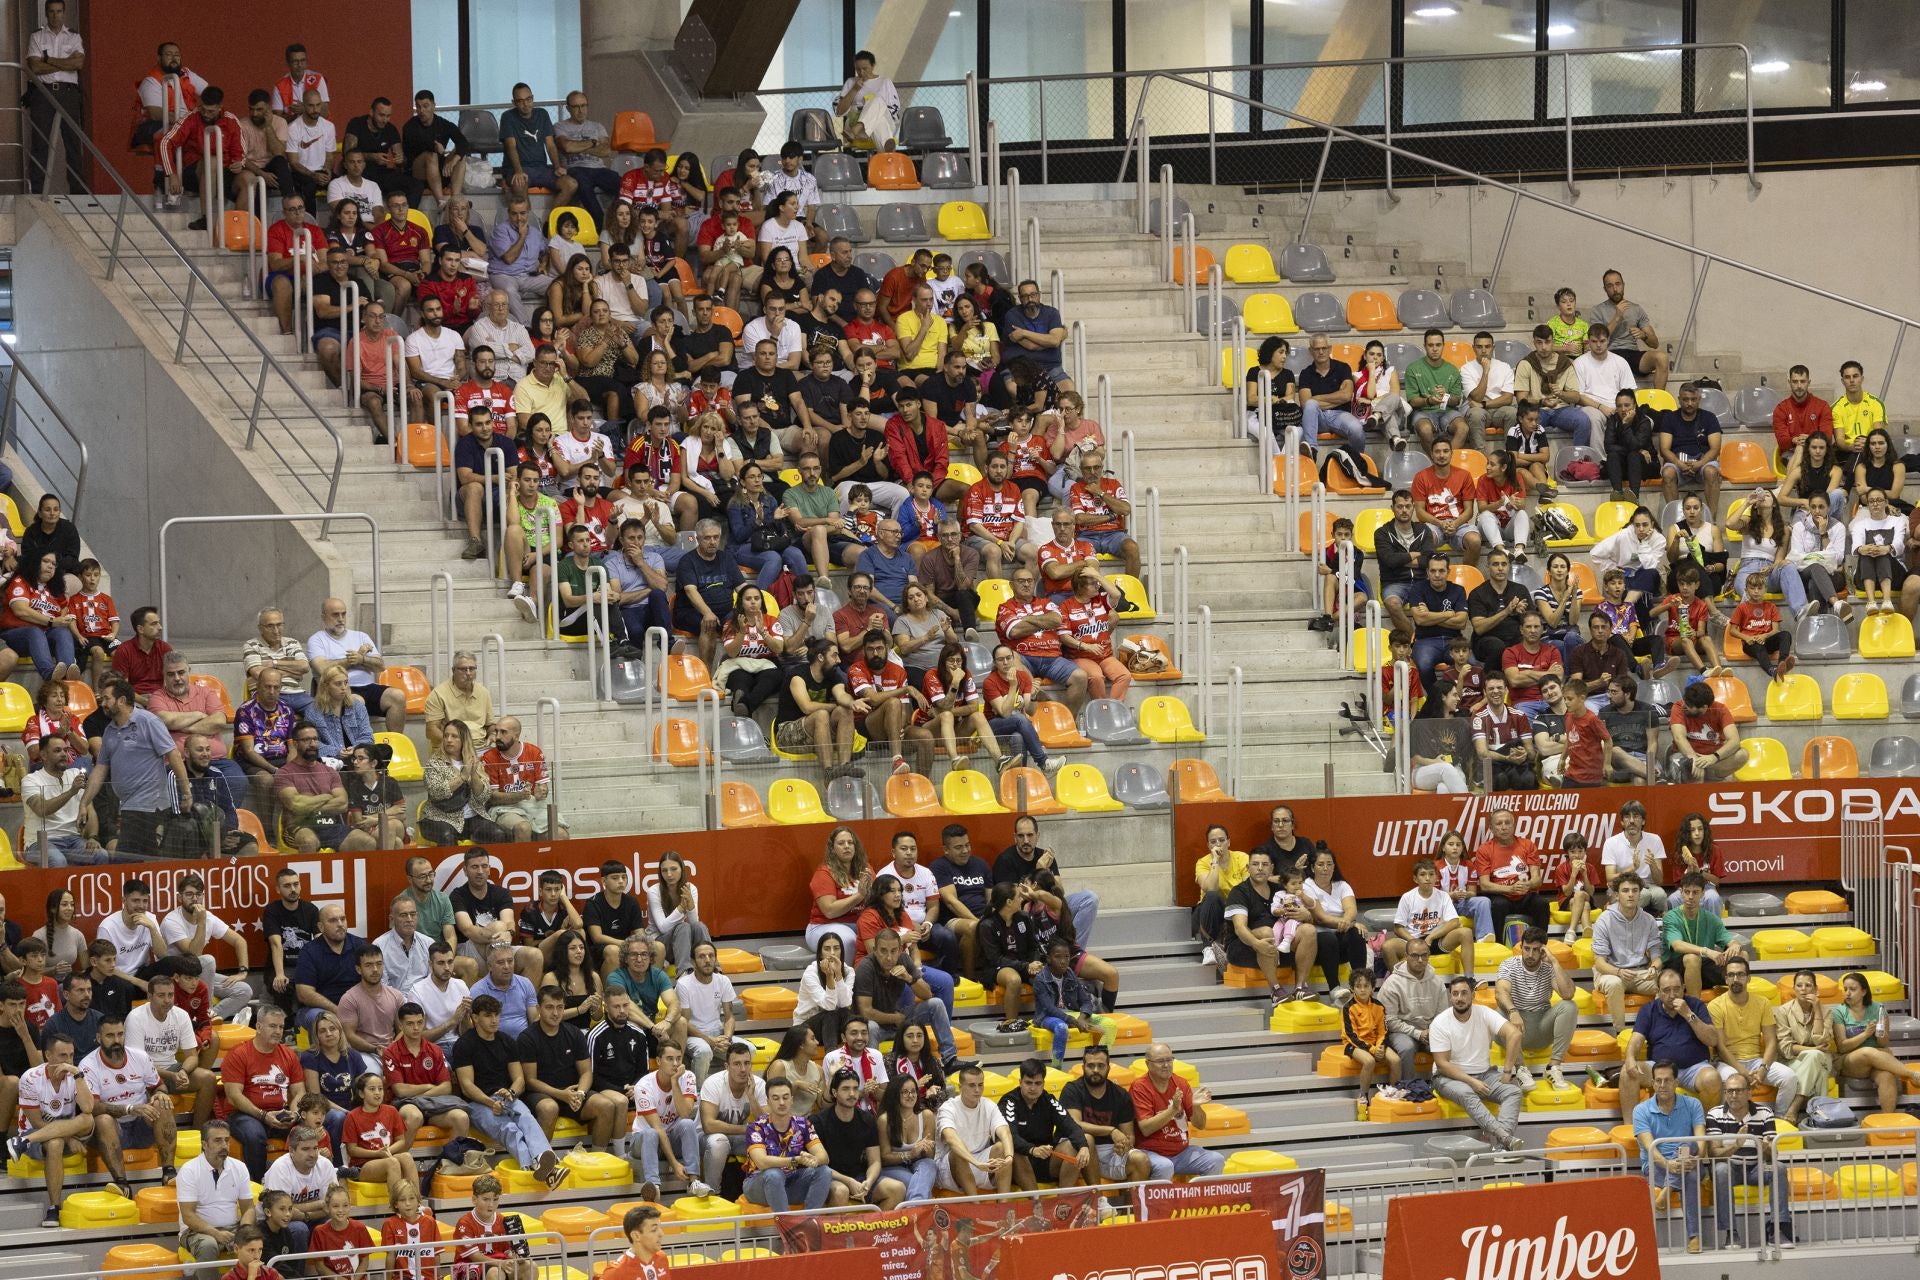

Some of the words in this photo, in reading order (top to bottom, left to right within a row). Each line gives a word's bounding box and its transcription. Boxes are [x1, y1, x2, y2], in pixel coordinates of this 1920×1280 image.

[1524, 793, 1580, 812] VOLCANO
[1708, 787, 1920, 826] SKODA
[1372, 818, 1449, 857] ULTRA
[1474, 812, 1617, 853] MRATHON
[953, 875, 985, 887] adidas
[1413, 911, 1439, 920] SUPER
[1148, 1186, 1201, 1200] JONATHAN
[1203, 1182, 1252, 1196] HENRIQUE
[1279, 1177, 1305, 1241] 7
[823, 1221, 857, 1234] Pablo
[901, 1216, 909, 1226] 9
[396, 1248, 431, 1259] Jimee
[891, 1246, 916, 1258] Pablo
[1443, 1215, 1638, 1280] Jimbee
